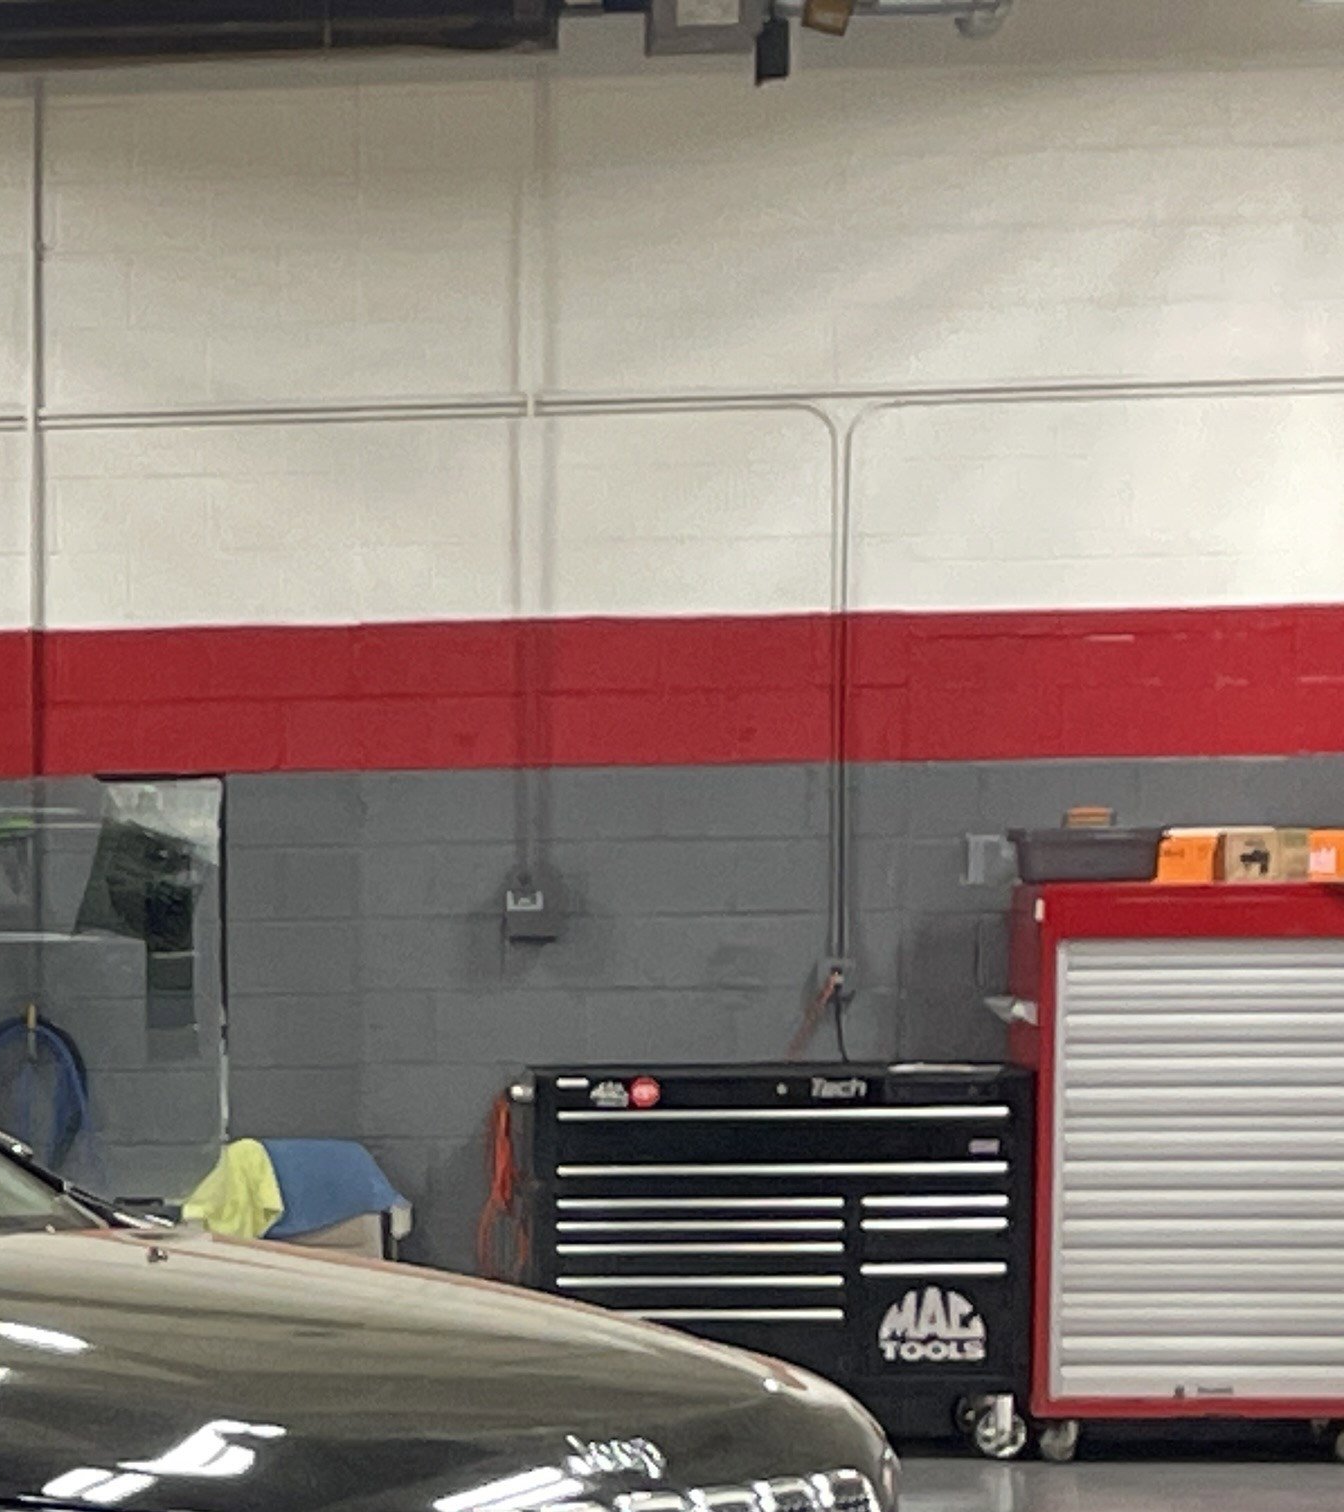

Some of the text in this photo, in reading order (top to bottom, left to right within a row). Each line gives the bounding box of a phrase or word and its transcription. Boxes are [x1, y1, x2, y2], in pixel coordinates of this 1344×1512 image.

[878, 1285, 986, 1340] MAC
[879, 1340, 985, 1361] TOOLS
[566, 1434, 664, 1479] Jeep
